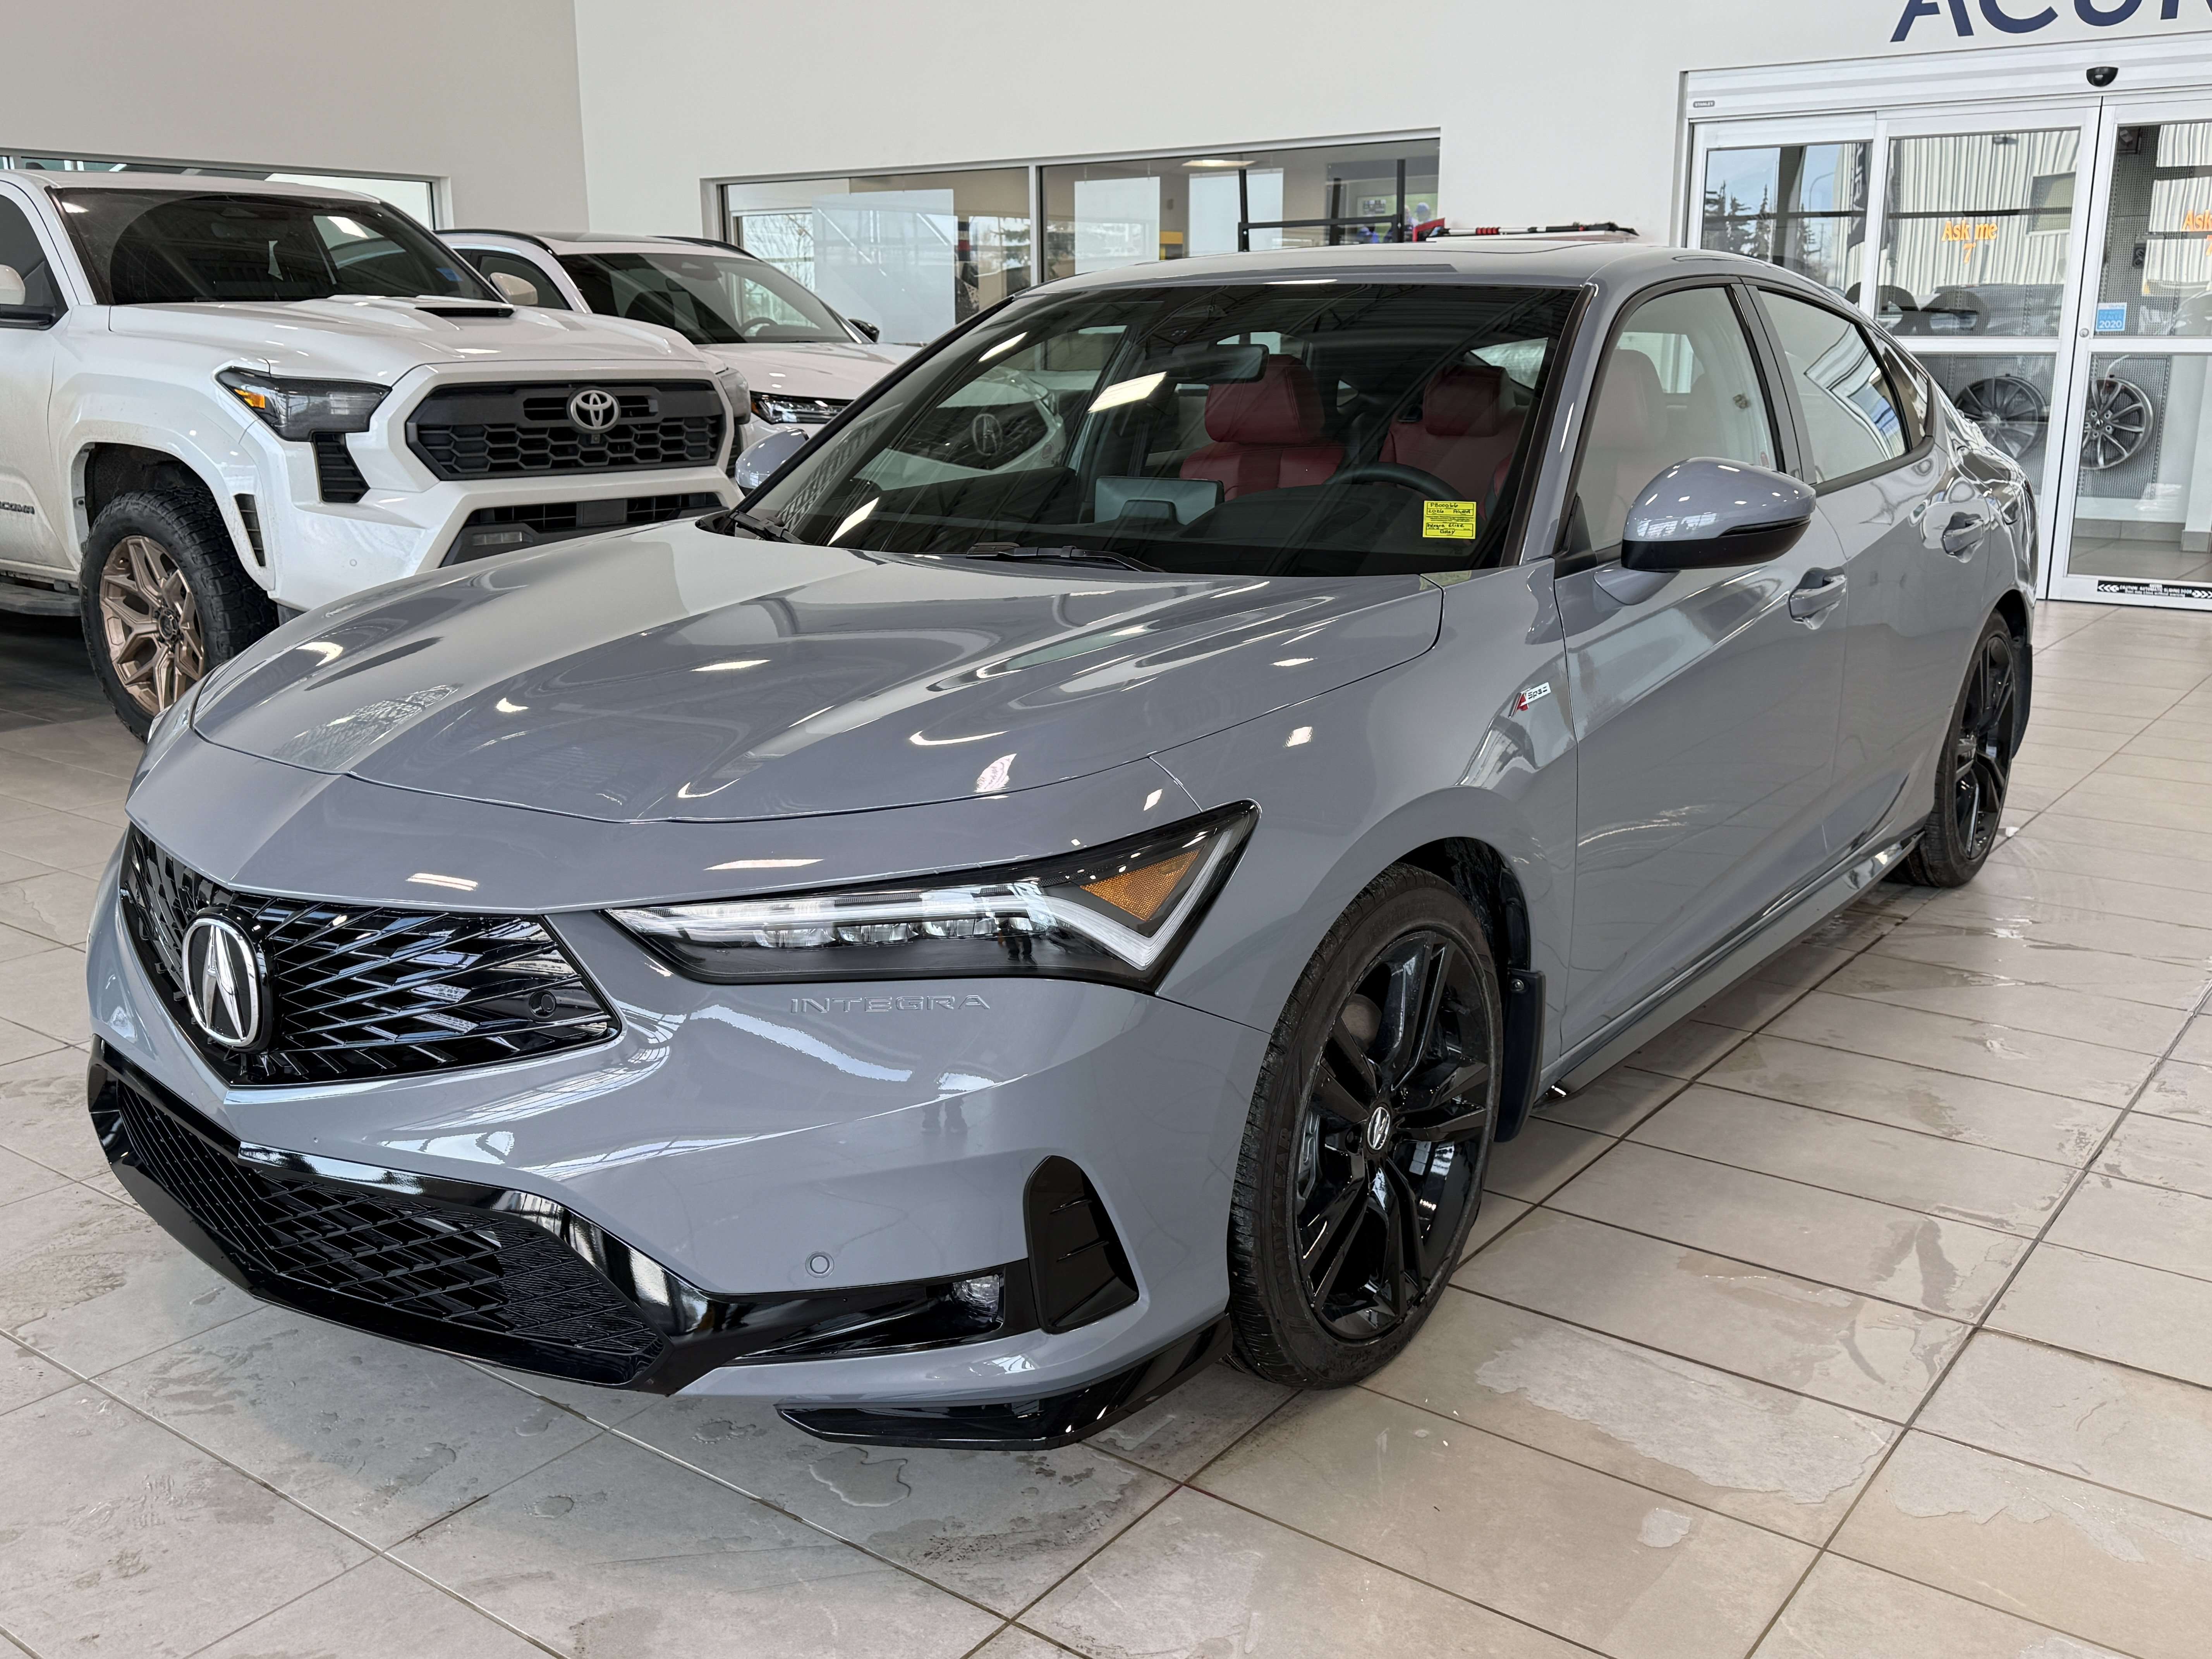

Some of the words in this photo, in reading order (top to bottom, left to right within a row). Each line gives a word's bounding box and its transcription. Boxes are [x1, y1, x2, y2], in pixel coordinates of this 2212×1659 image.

[1941, 219, 1971, 241] Ask
[1975, 223, 1998, 240] me
[2099, 320, 2122, 329] 2020
[790, 994, 991, 1013] INTEGRA
